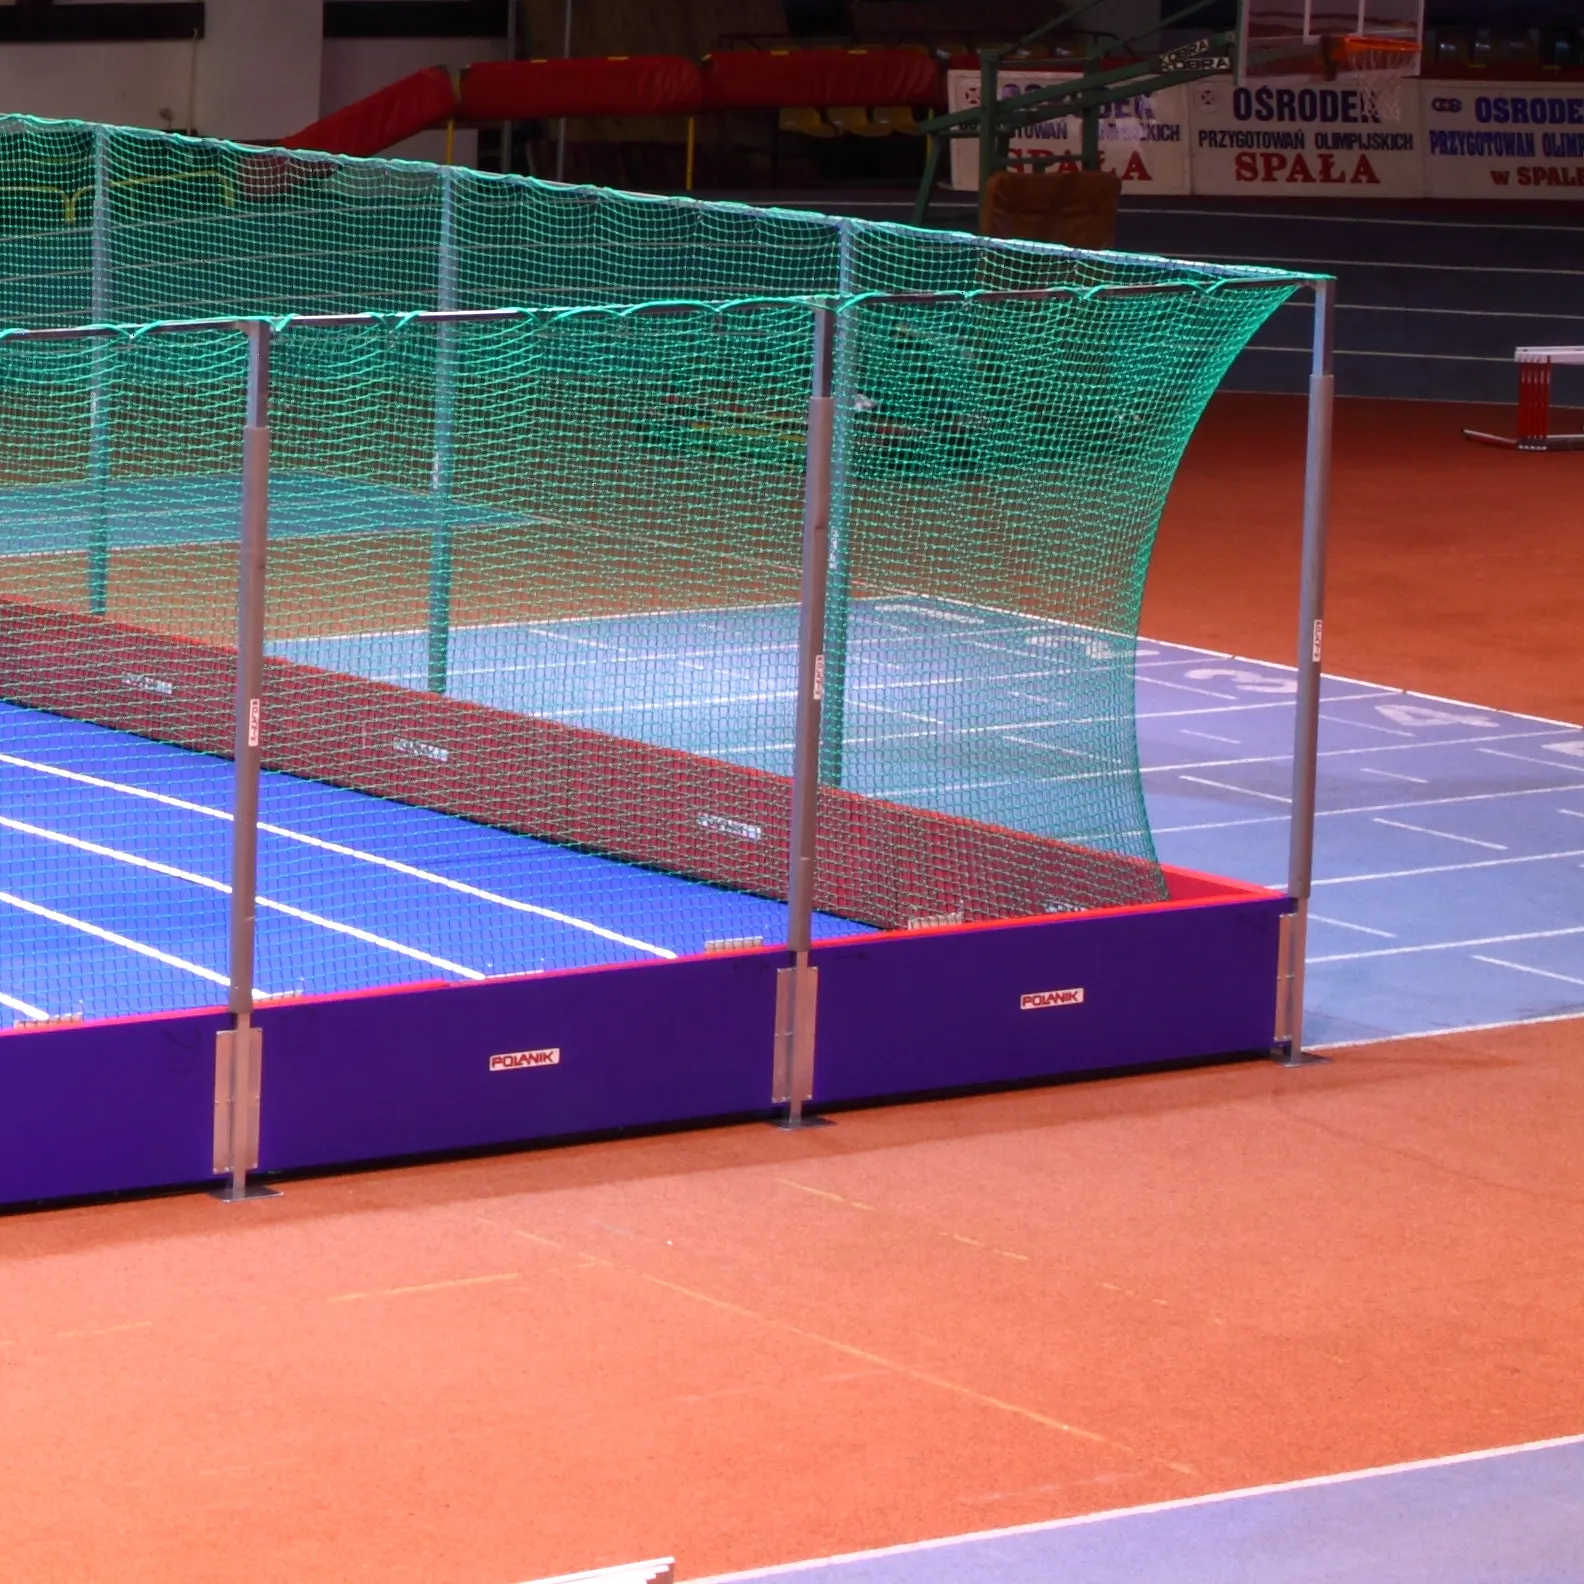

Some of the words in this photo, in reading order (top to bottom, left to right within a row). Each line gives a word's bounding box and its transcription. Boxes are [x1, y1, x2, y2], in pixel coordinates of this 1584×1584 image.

[1233, 85, 1382, 124] OŚRODEK
[1198, 128, 1305, 150] PRZYGOTOWAŃ
[1314, 132, 1414, 152] OLIMPIJSKICH
[1235, 152, 1381, 184] SPAŁA
[1022, 992, 1079, 1008] POLANIK
[491, 1051, 552, 1068] POLANIK
